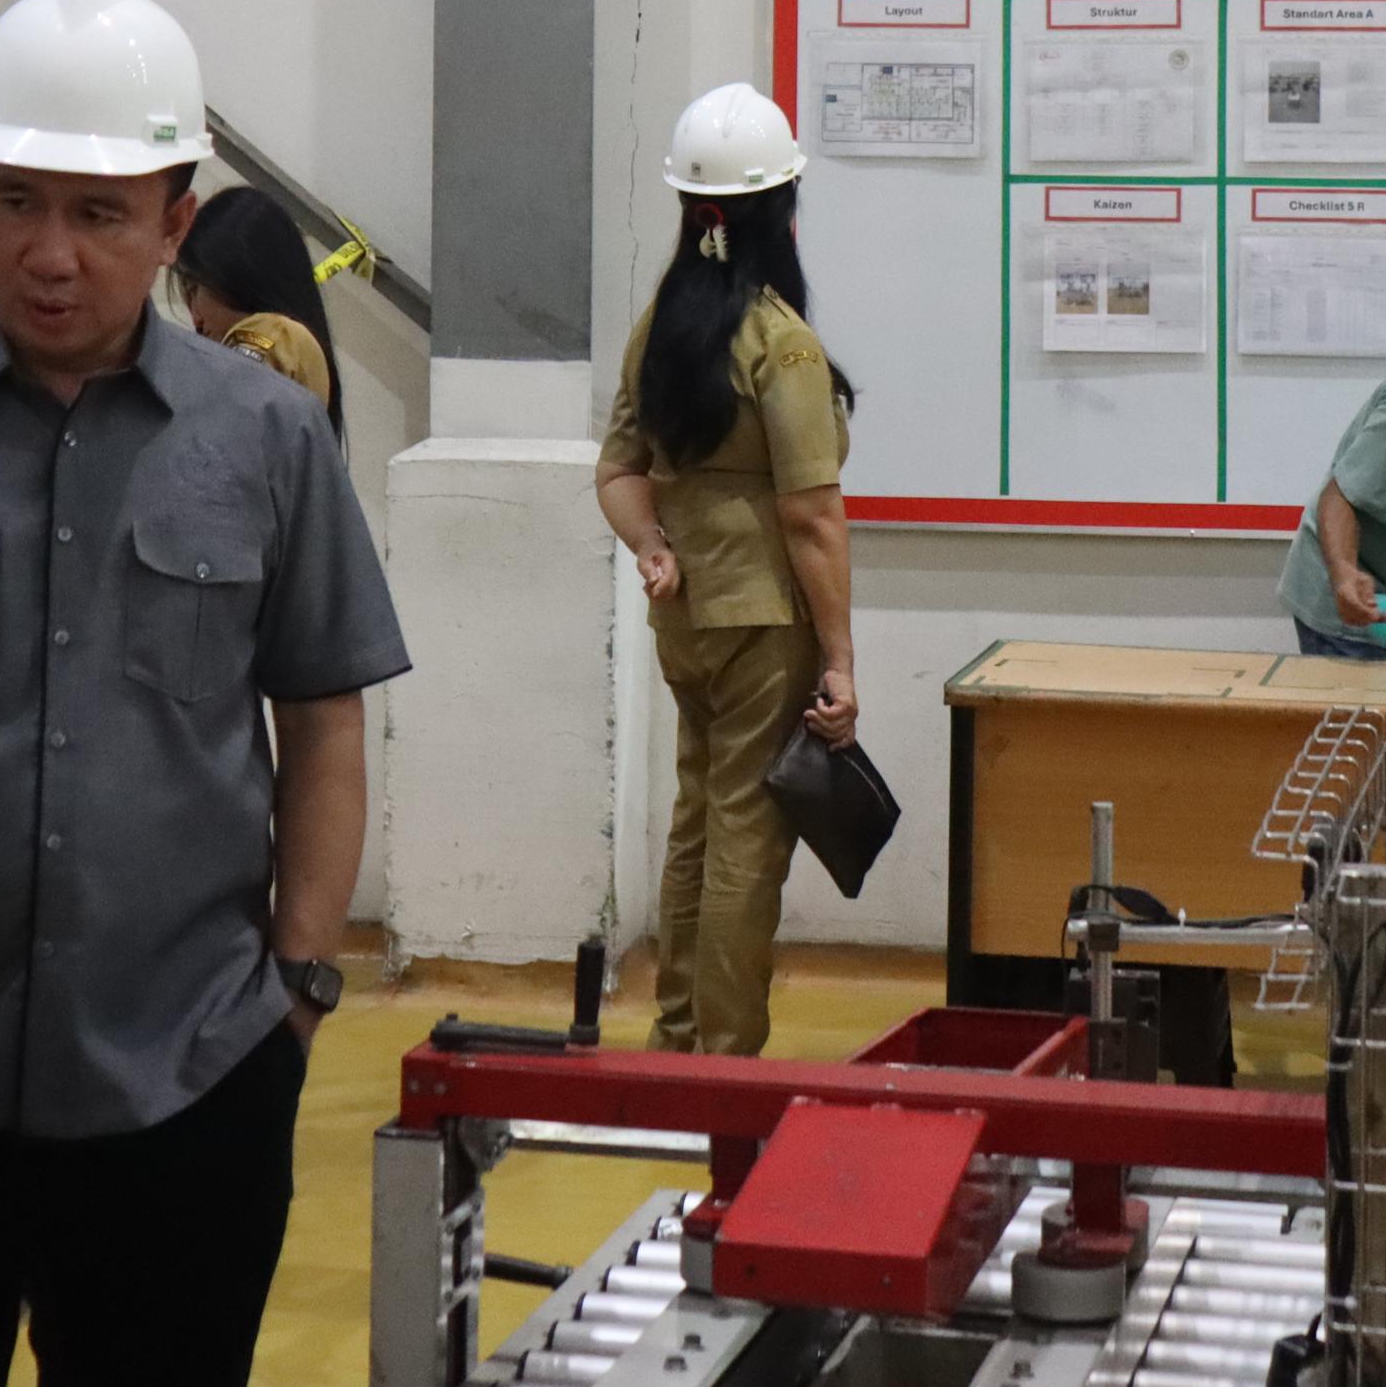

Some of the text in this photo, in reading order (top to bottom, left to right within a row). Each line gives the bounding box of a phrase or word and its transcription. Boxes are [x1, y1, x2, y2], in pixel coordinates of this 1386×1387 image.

[884, 4, 923, 17] Layout
[1089, 5, 1138, 18] Struktur
[1282, 7, 1374, 19] Standart Area A
[1092, 198, 1133, 210] Kaizen
[1288, 199, 1346, 212] Checklist
